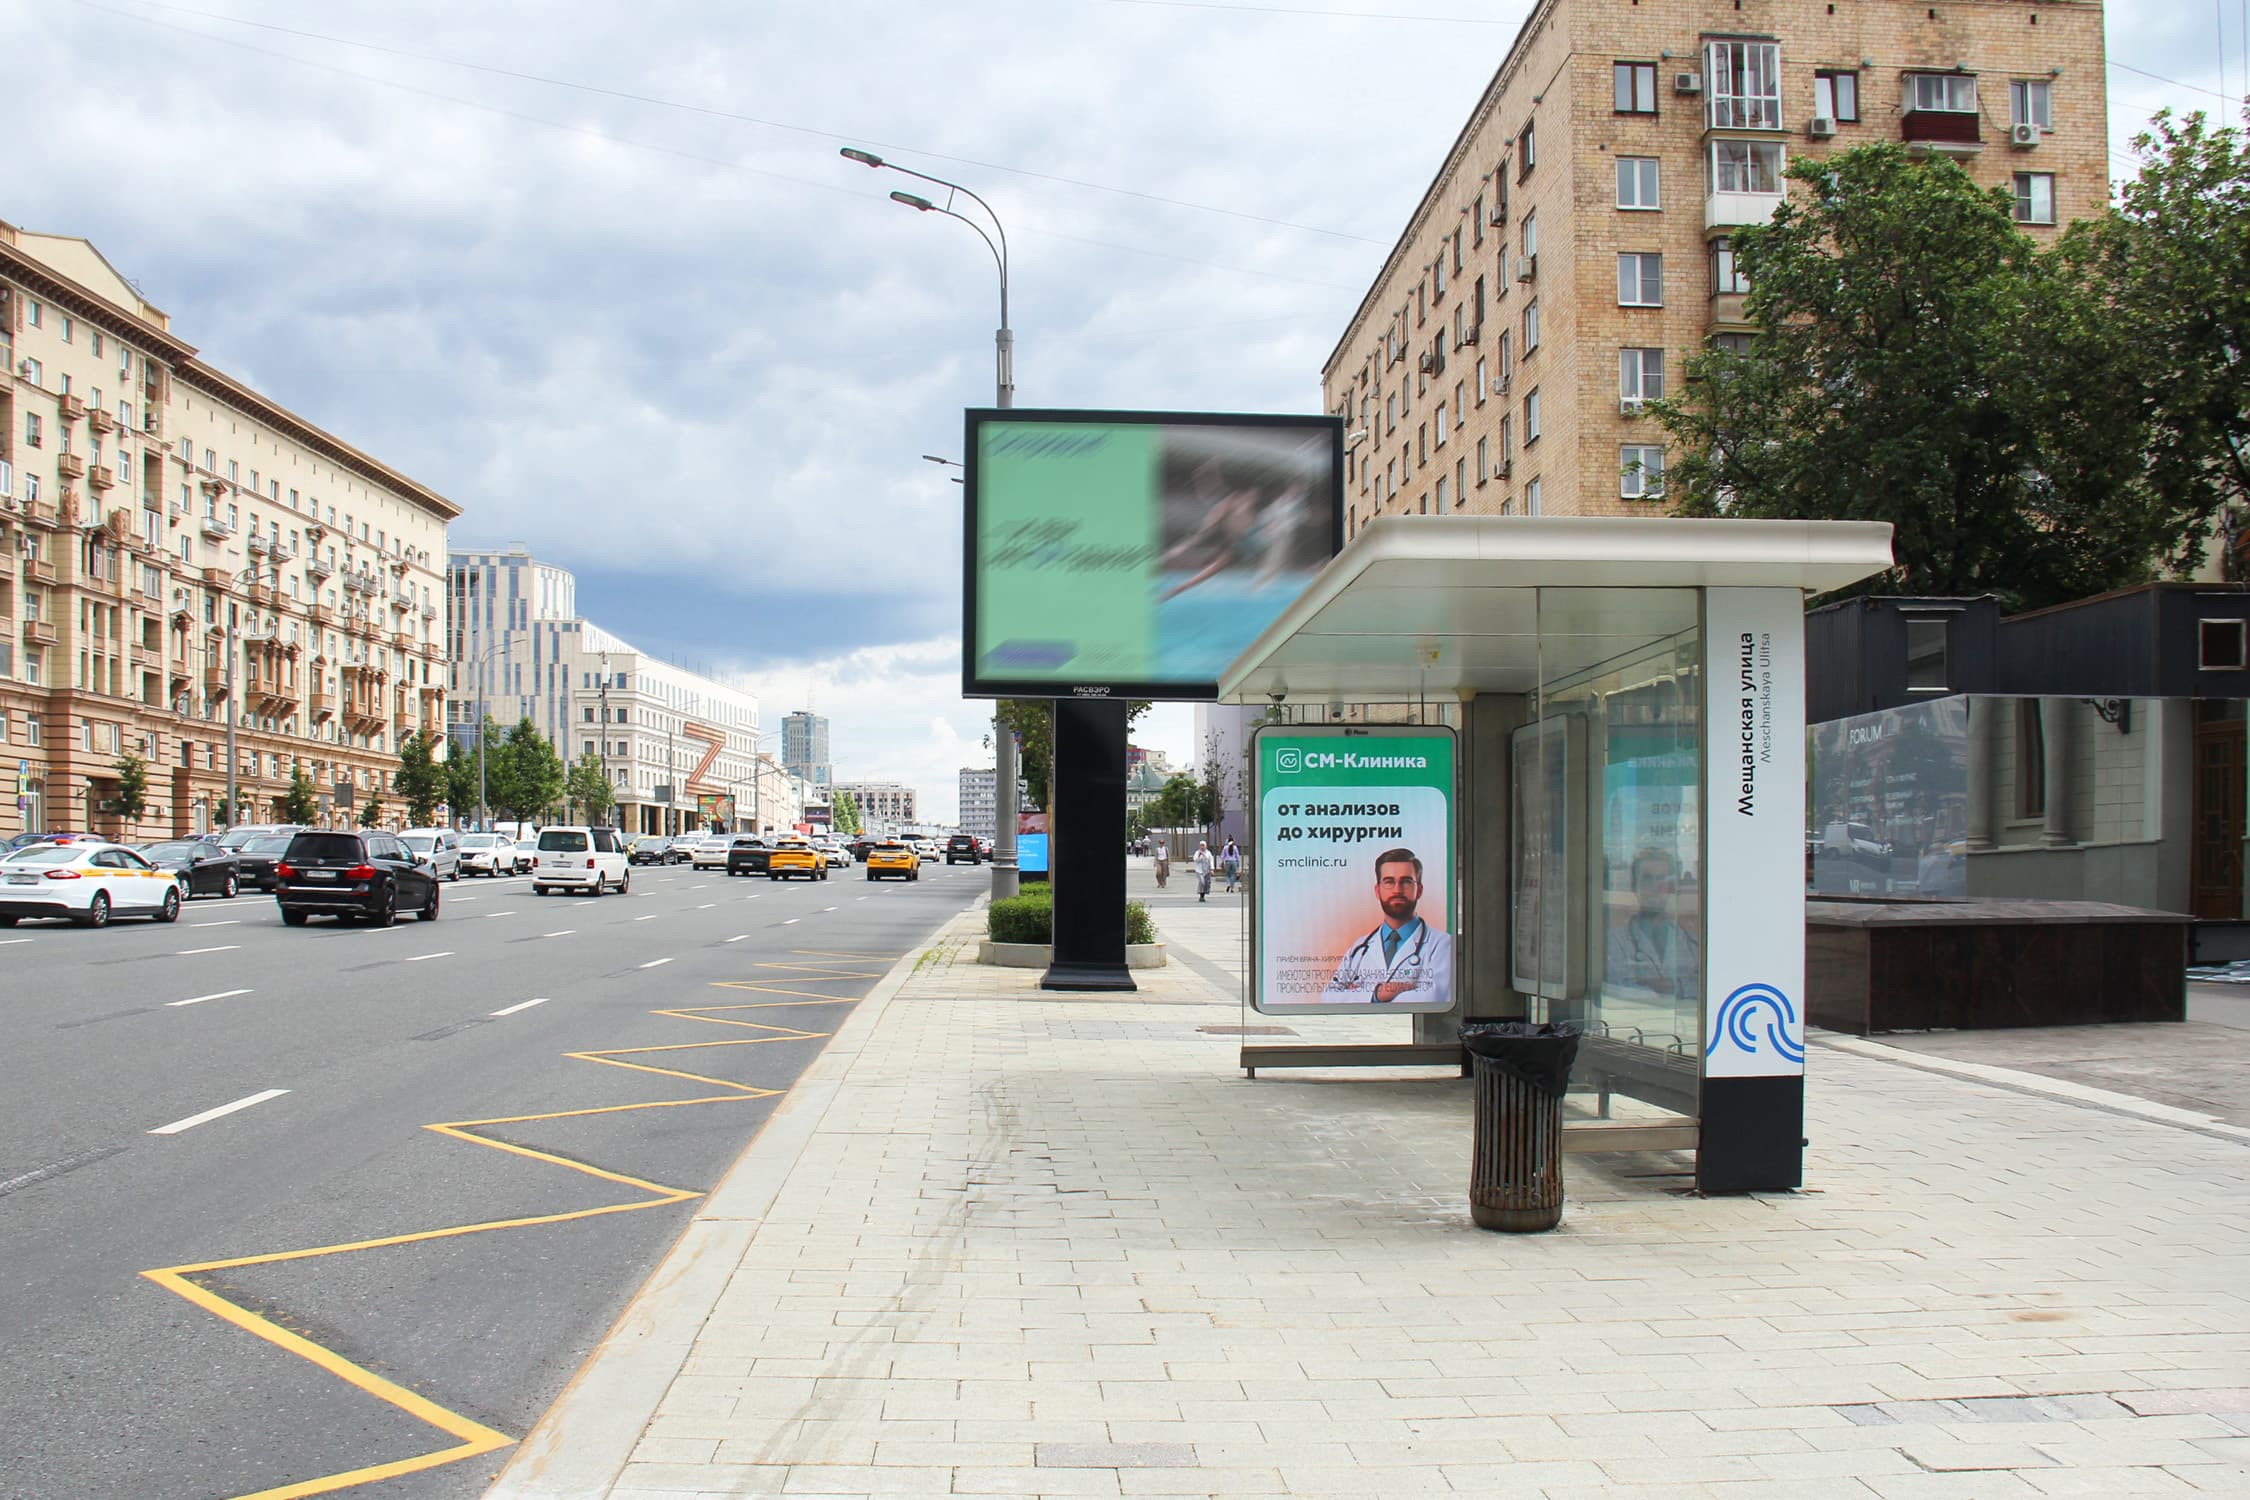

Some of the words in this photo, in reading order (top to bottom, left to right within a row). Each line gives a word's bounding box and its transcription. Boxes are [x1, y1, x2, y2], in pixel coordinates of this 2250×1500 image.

[1760, 633, 1771, 667] Ulitsa
[1740, 633, 1757, 692] улица
[1760, 672, 1773, 764] Meschanskaya
[1850, 724, 1882, 745] FORUM
[1304, 752, 1427, 769] СМ-Клиника
[1738, 698, 1756, 816] Мещанская
[1277, 804, 1299, 816] от
[1304, 804, 1400, 816] анализов
[1277, 826, 1303, 841] до
[1307, 826, 1402, 843] хирургии
[1278, 856, 1347, 868] smclinic.ru
